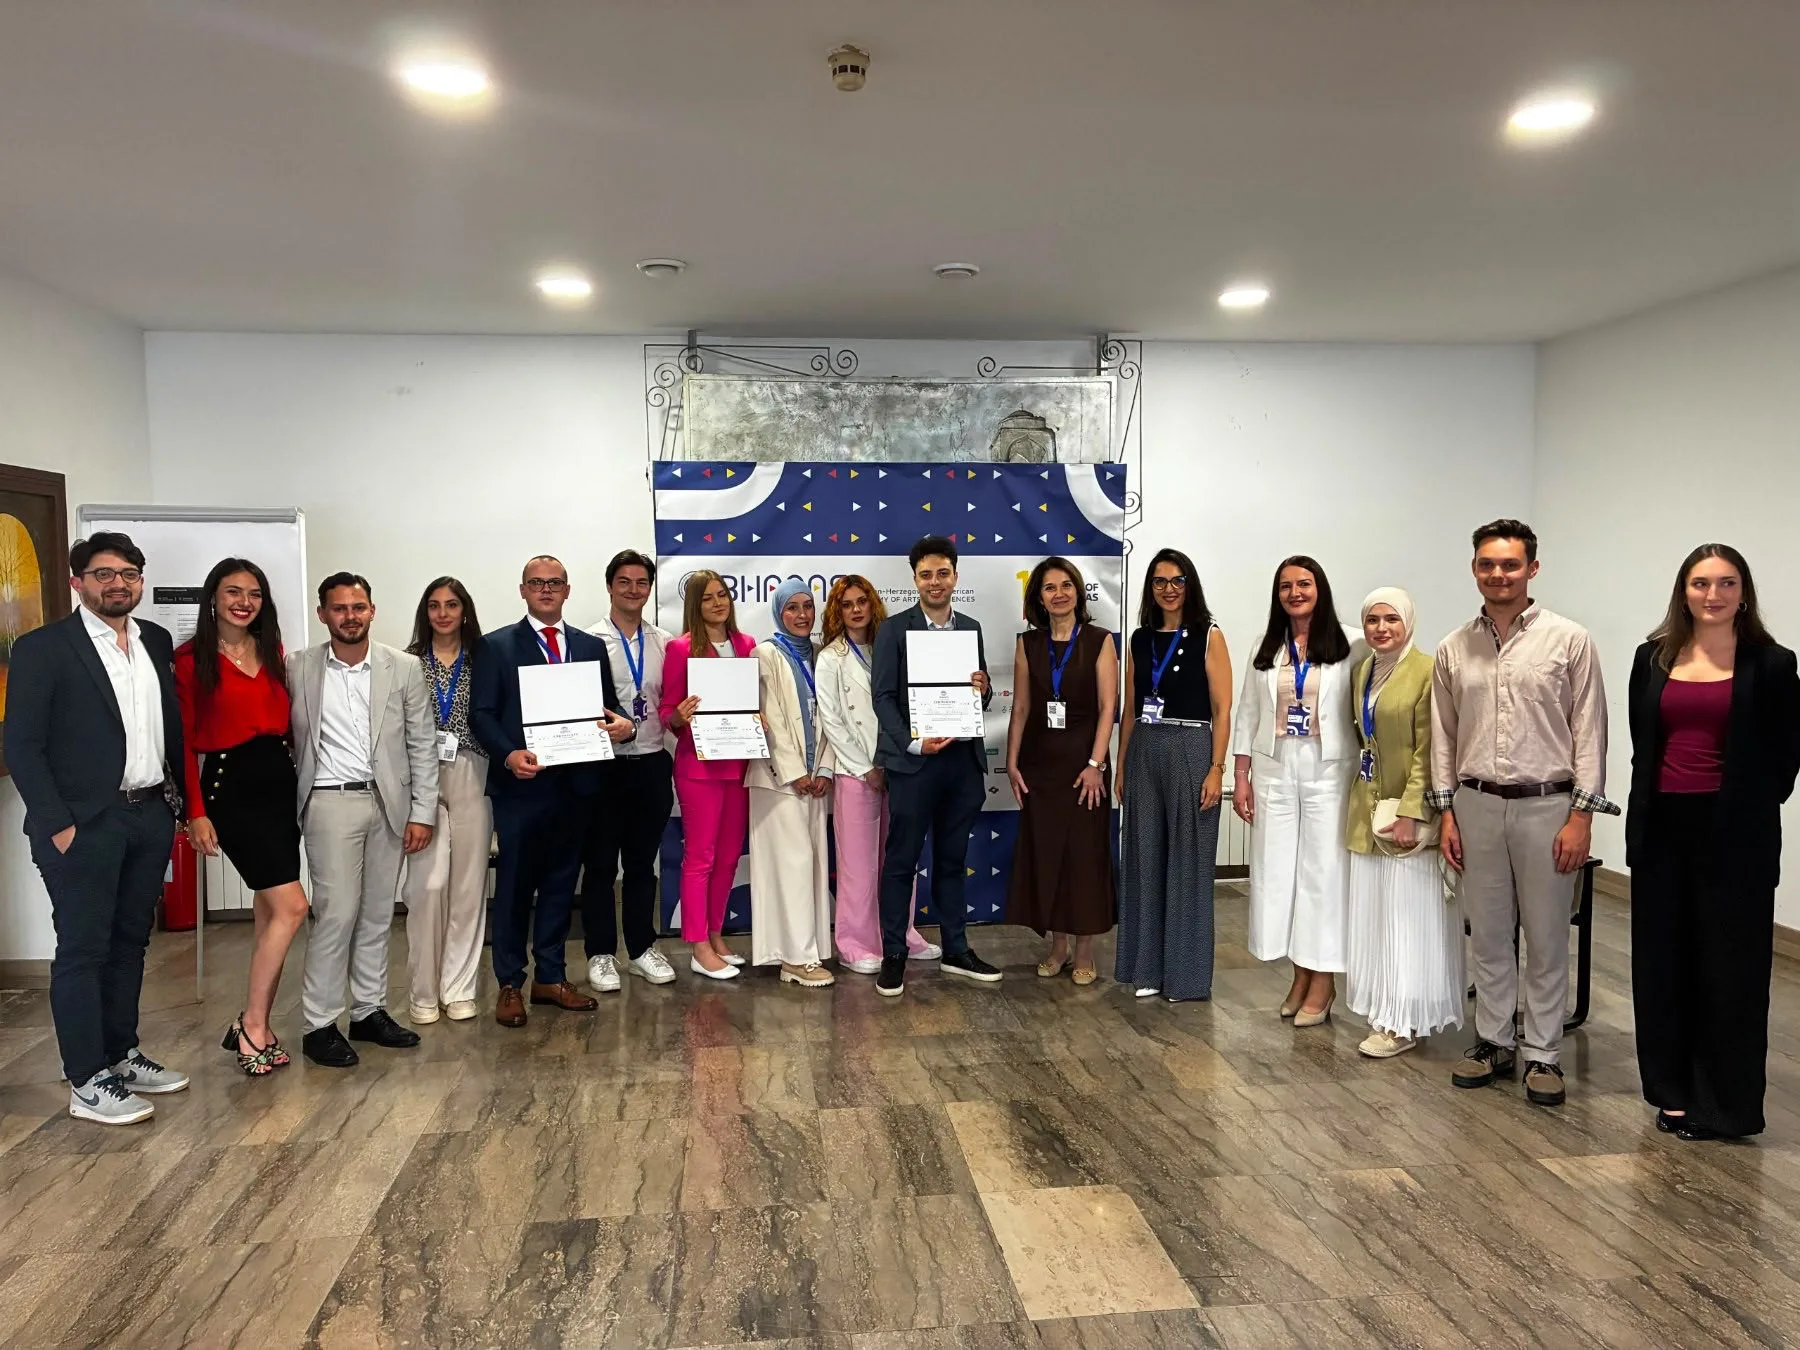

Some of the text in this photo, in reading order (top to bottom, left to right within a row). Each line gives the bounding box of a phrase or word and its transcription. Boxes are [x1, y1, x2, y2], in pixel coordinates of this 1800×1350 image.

[720, 574, 848, 603] BHAA
[1085, 583, 1099, 592] OF
[877, 588, 921, 597] n-Herzegov
[1085, 593, 1099, 602] AS
